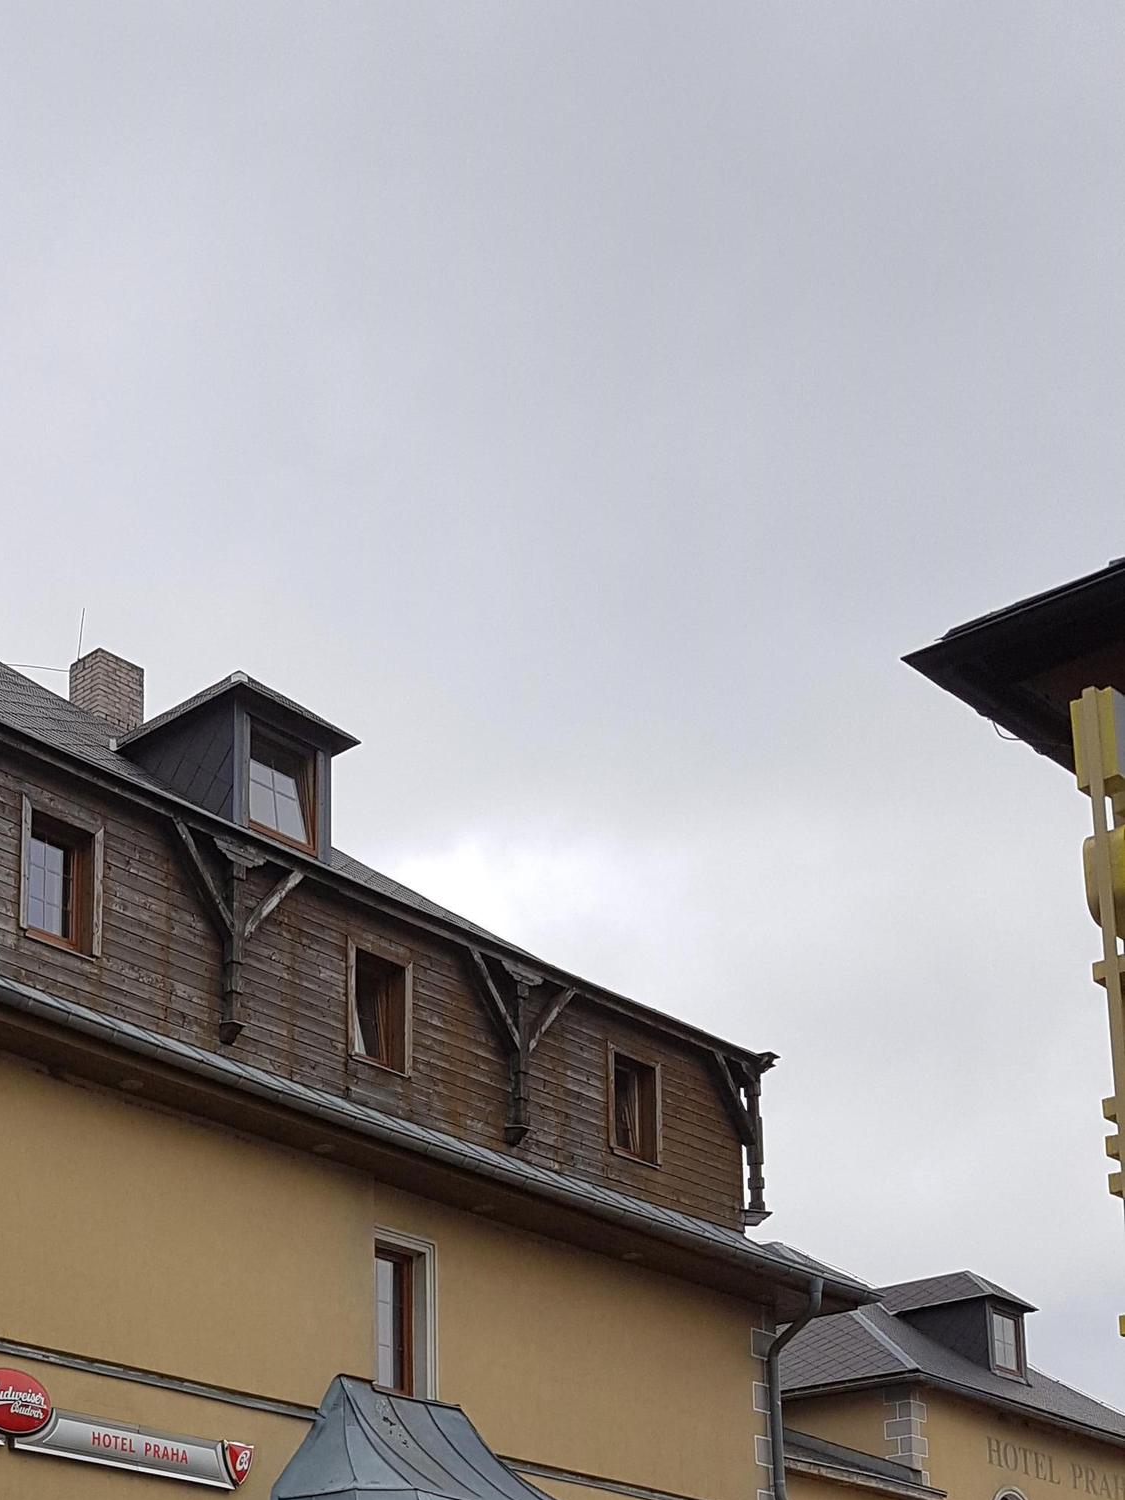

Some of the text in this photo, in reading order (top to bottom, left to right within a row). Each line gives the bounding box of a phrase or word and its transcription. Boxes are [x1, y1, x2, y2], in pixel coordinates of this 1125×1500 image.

[10, 1400, 45, 1420] Budvar
[91, 1430, 189, 1465] HOTEL PRAHA
[986, 1435, 1061, 1485] HOTEL
